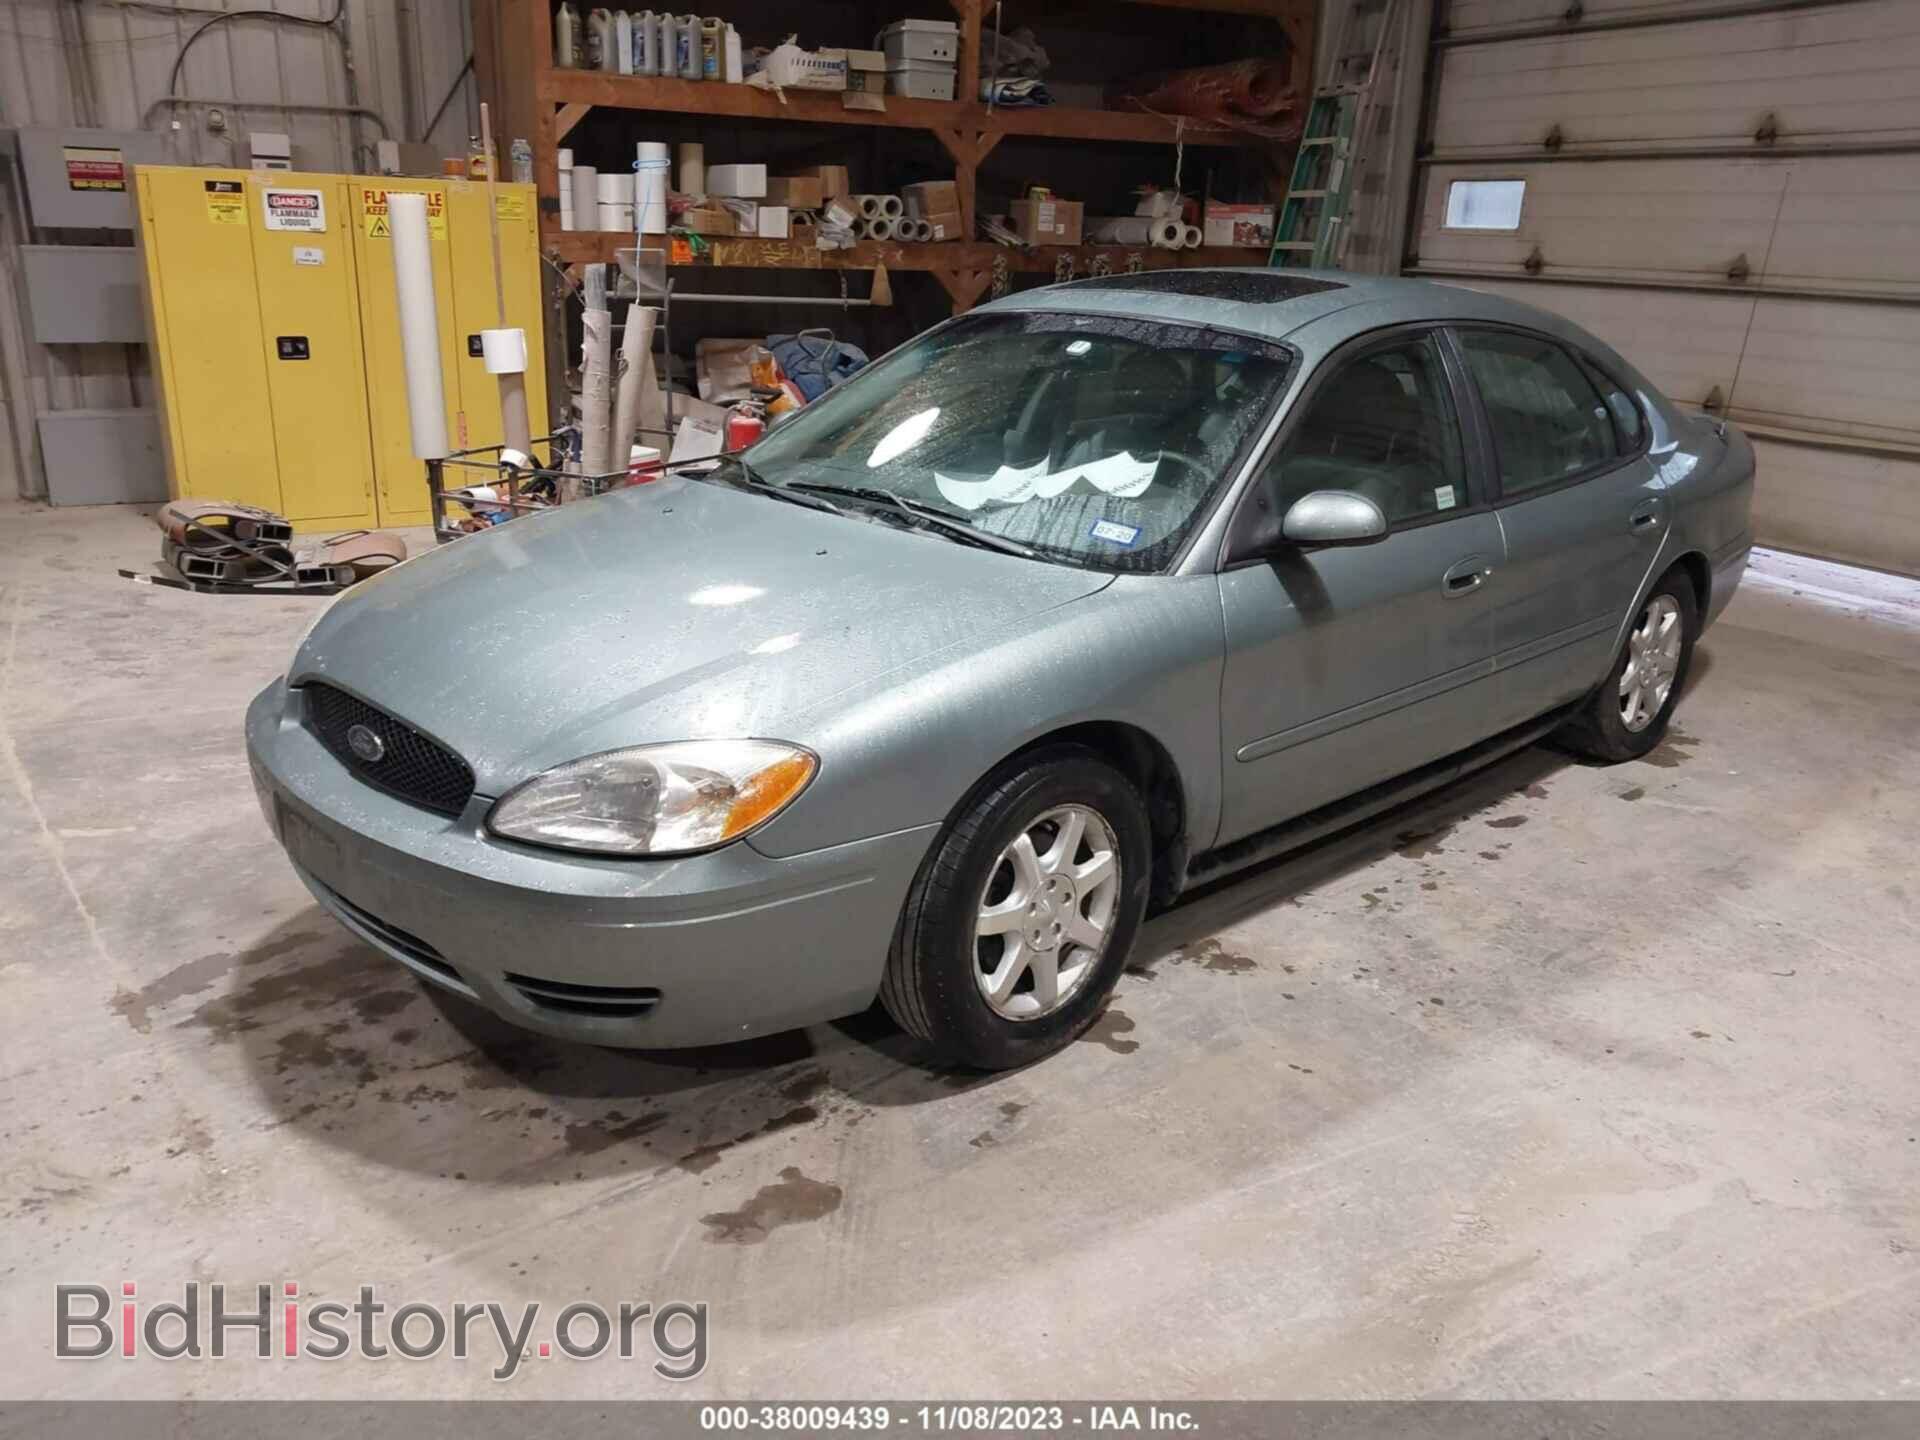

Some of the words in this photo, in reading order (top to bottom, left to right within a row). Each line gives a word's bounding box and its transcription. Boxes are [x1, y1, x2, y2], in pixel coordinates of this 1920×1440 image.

[271, 196, 318, 207] DANGER
[271, 209, 319, 217] FLAMMABLE
[280, 218, 311, 227] LIQUIDS
